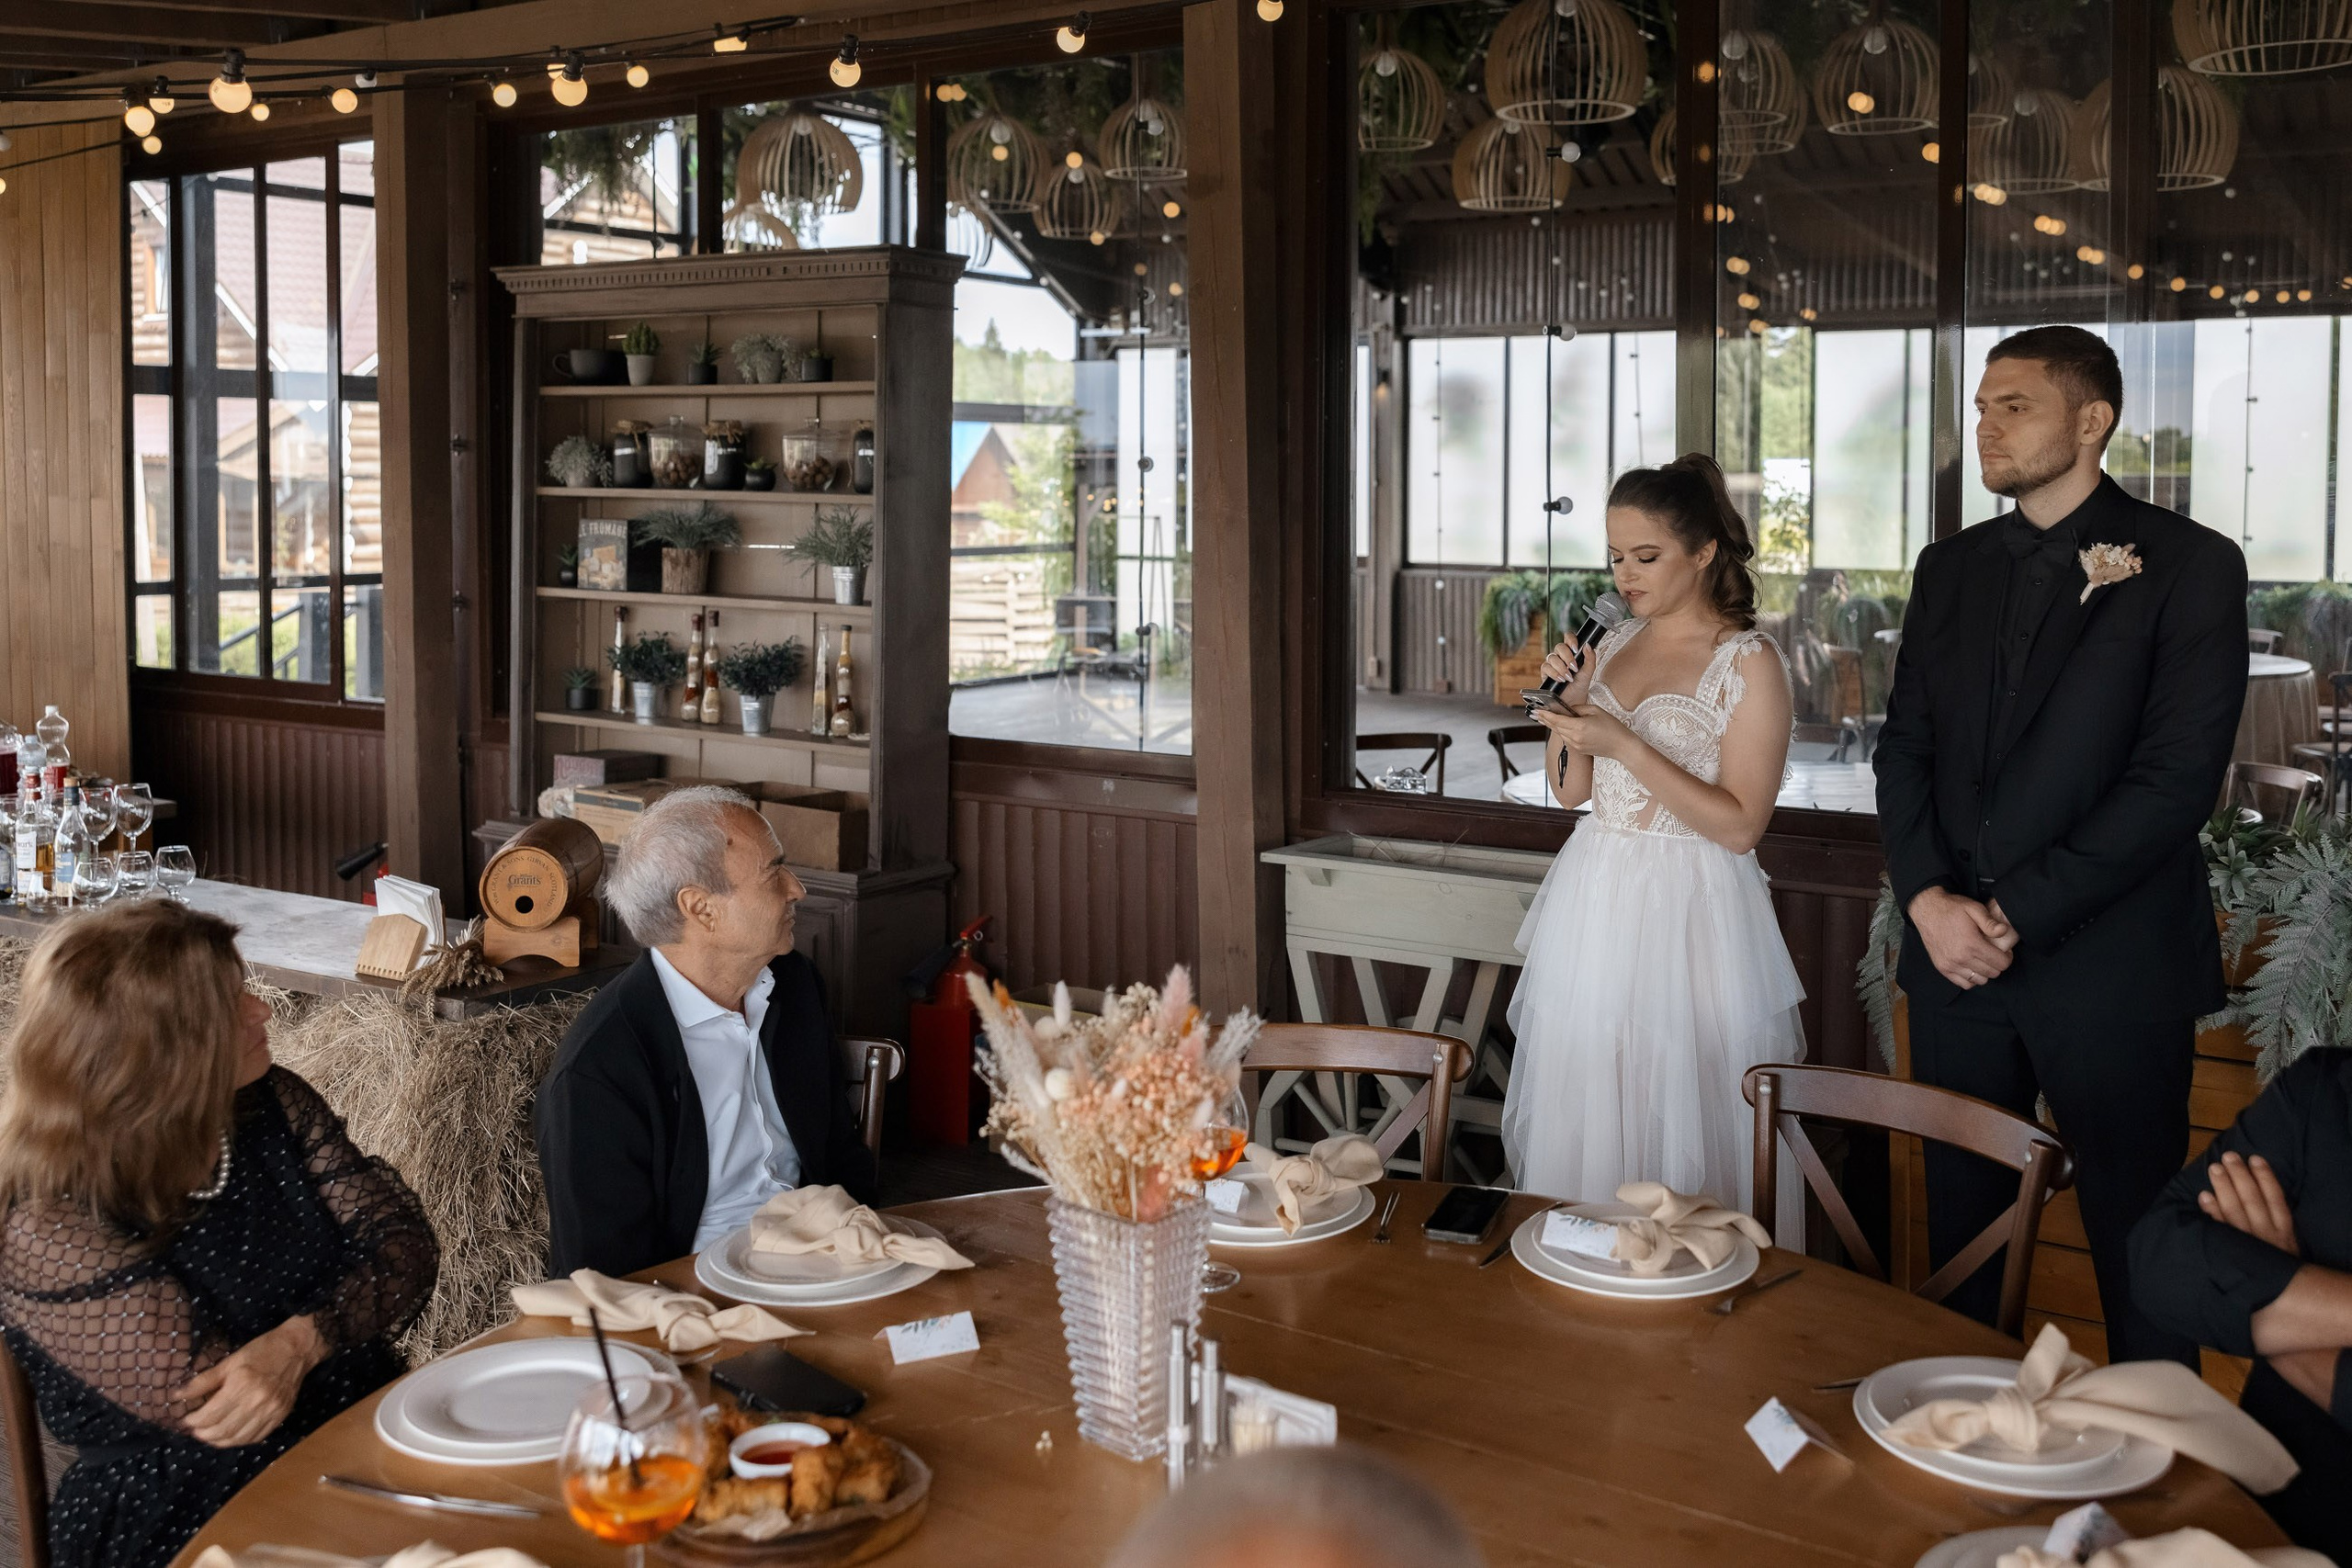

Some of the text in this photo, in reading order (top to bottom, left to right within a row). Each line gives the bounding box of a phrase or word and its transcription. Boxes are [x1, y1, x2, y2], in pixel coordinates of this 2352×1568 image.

[492, 868, 503, 891] GRANT
[507, 856, 525, 864] SONS
[527, 856, 549, 872] GIRVAN
[548, 872, 558, 907] SCOTLAND
